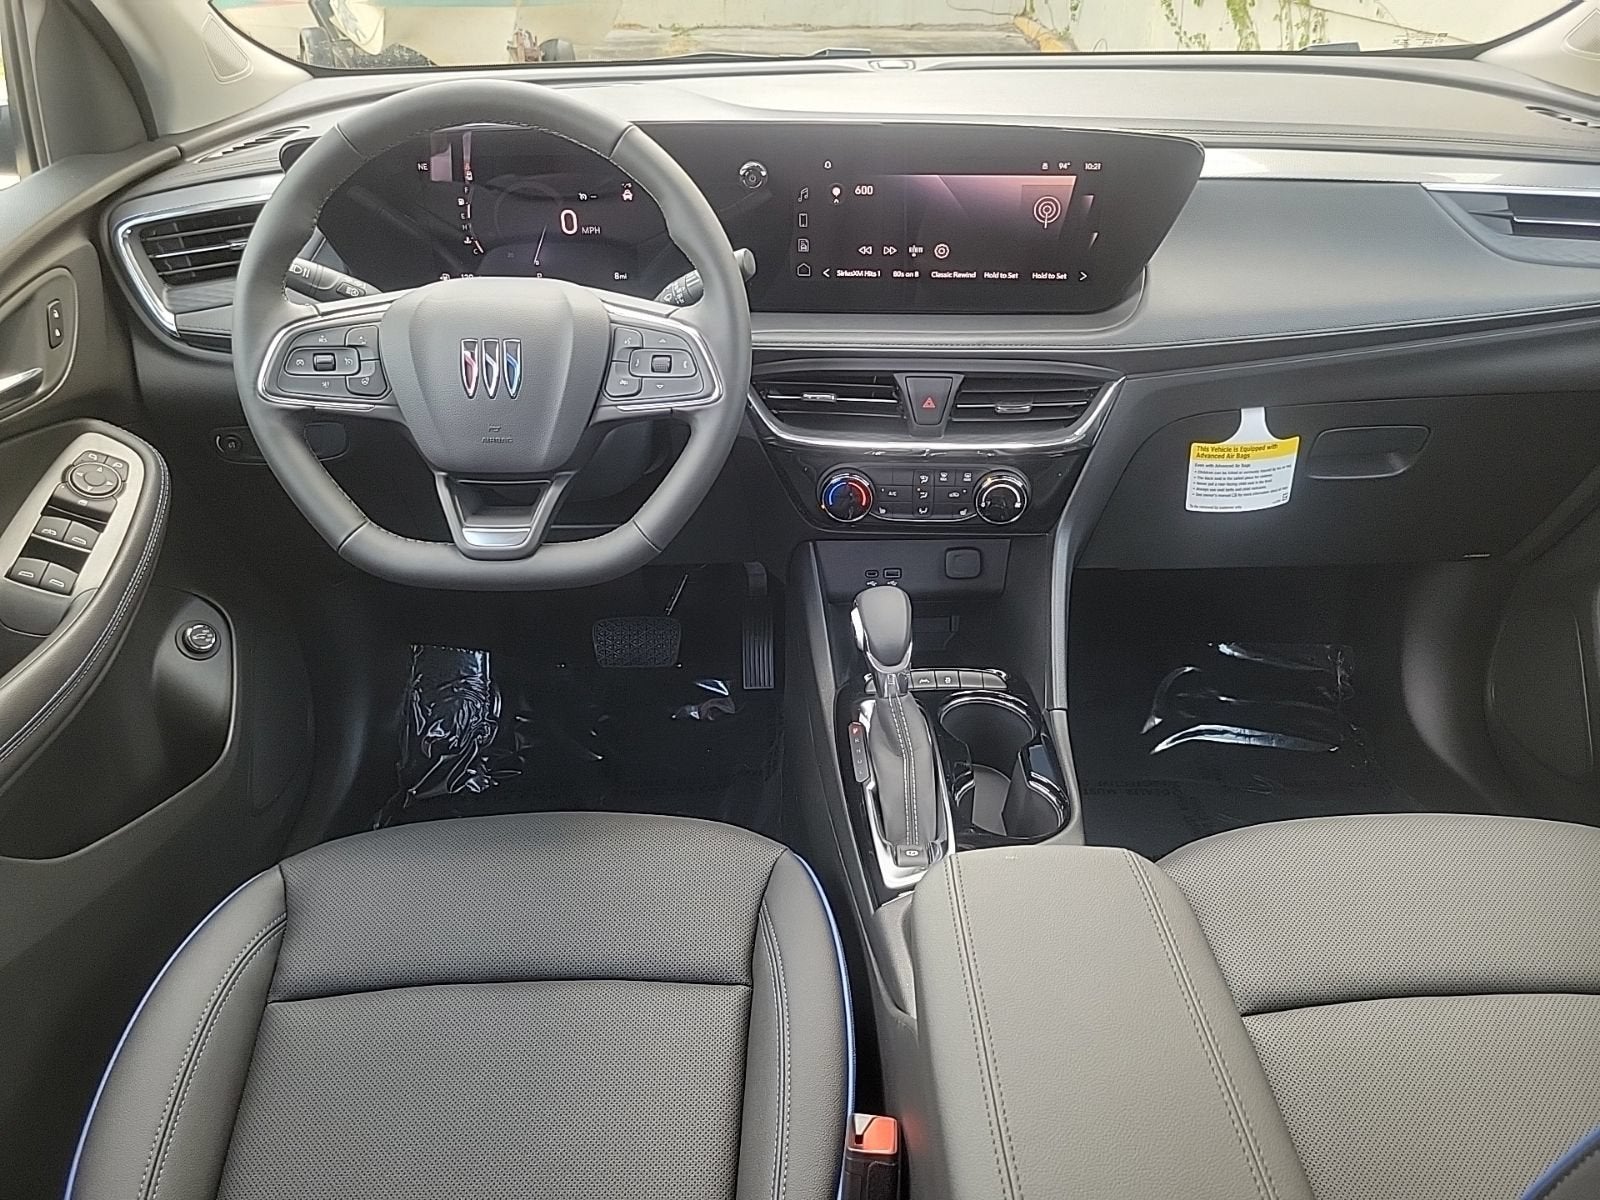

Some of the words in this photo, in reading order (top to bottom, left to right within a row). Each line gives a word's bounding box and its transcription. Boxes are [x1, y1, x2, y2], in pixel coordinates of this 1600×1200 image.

[417, 163, 429, 171] NE
[855, 185, 873, 196] 600
[560, 209, 578, 235] 0
[582, 226, 601, 235] MPH
[931, 271, 952, 279] Classic
[953, 271, 976, 279] Rewind
[984, 271, 999, 279] Hold
[1000, 271, 1007, 279] to
[1008, 271, 1019, 279] Set
[1032, 272, 1047, 280] Hold
[1048, 272, 1055, 280] to
[1056, 272, 1067, 280] Set
[1240, 445, 1266, 454] Equipped
[1236, 452, 1251, 460] Bags
